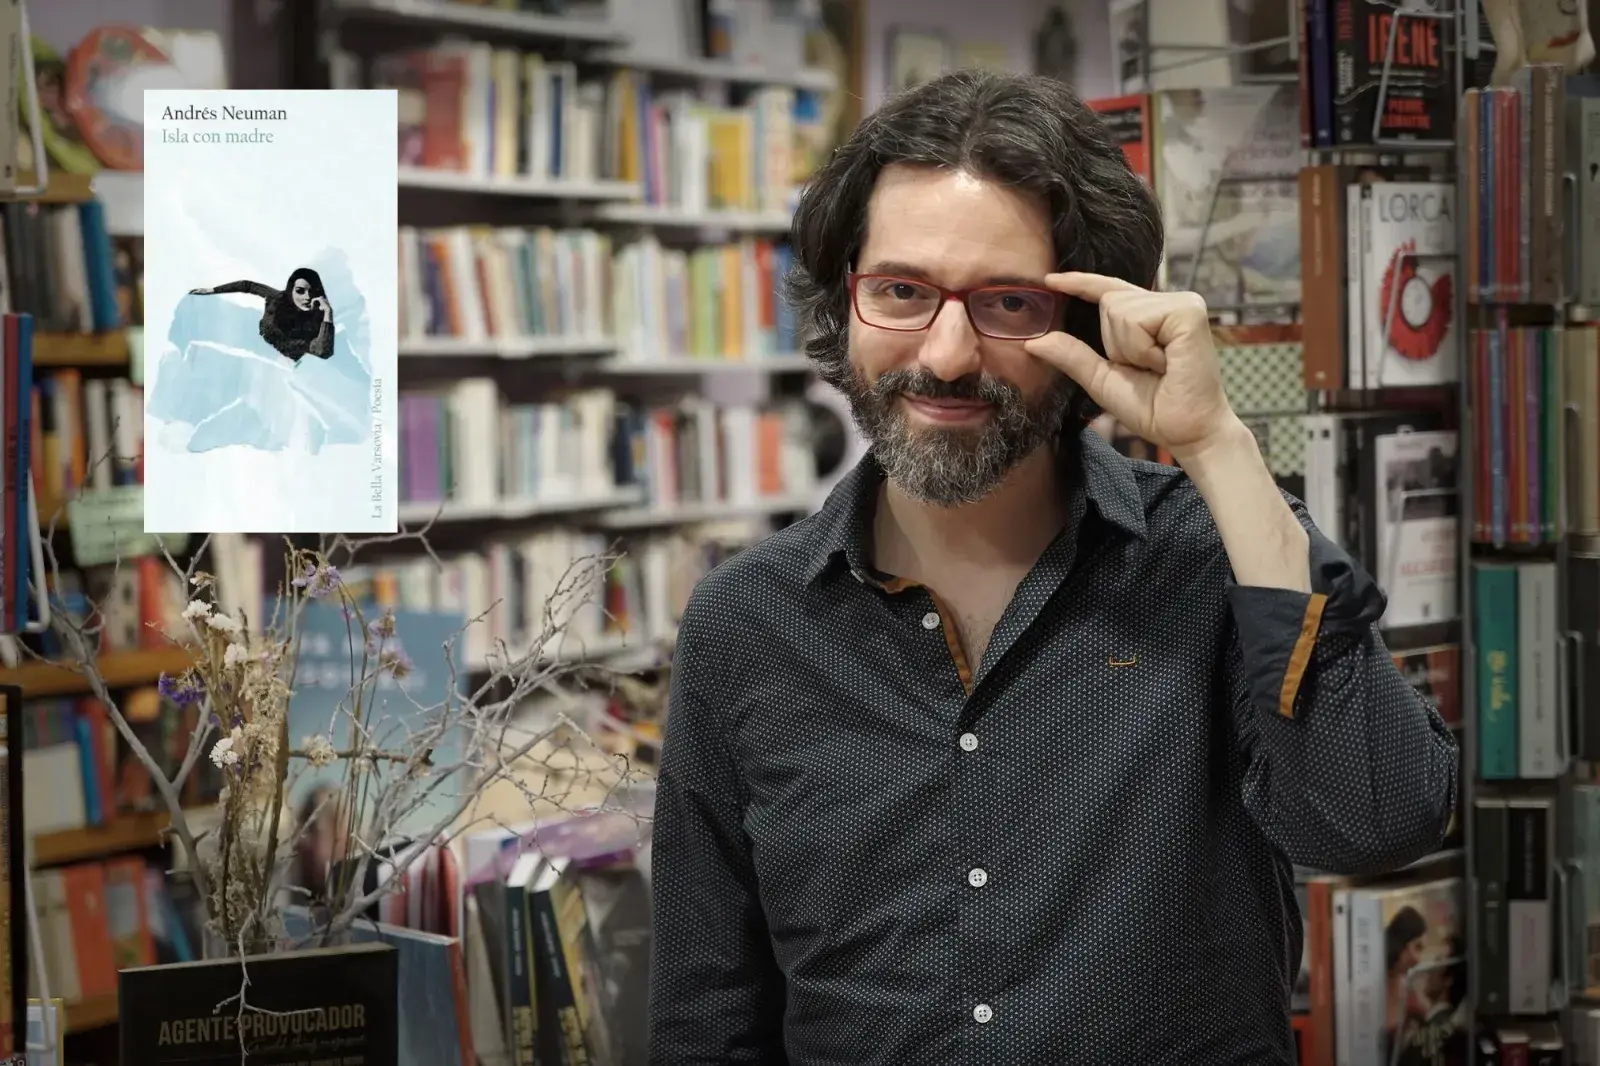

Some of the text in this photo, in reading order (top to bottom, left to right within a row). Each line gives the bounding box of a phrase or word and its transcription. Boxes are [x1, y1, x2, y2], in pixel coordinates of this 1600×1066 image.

[1379, 192, 1453, 224] LORCA
[158, 1016, 235, 1046] AGENTE
[243, 1003, 366, 1038] PROVOCADOR
